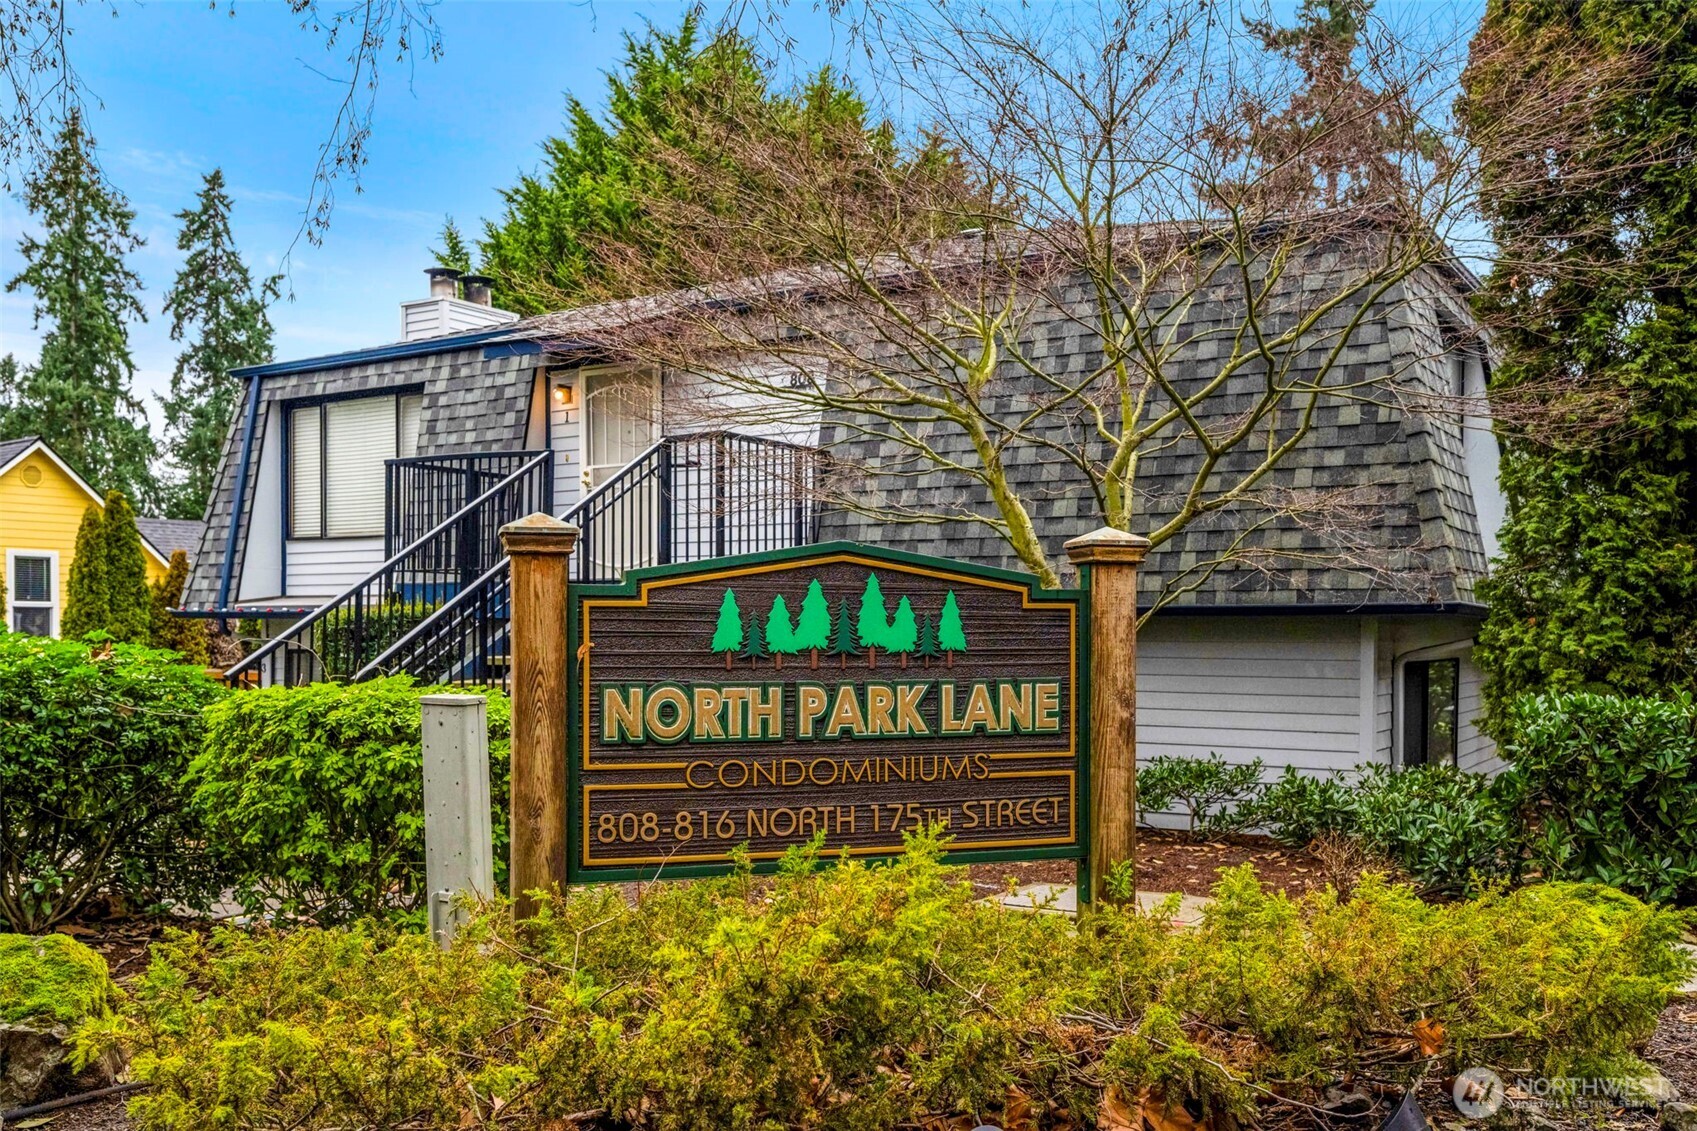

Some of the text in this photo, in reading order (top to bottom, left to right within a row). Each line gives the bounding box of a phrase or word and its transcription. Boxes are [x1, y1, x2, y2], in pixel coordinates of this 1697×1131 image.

[602, 681, 1063, 743] NORTH PARK LANE
[686, 753, 991, 789] CONDOMINIUMS
[597, 797, 1064, 844] 808-816 NORTH 175TH STREET
